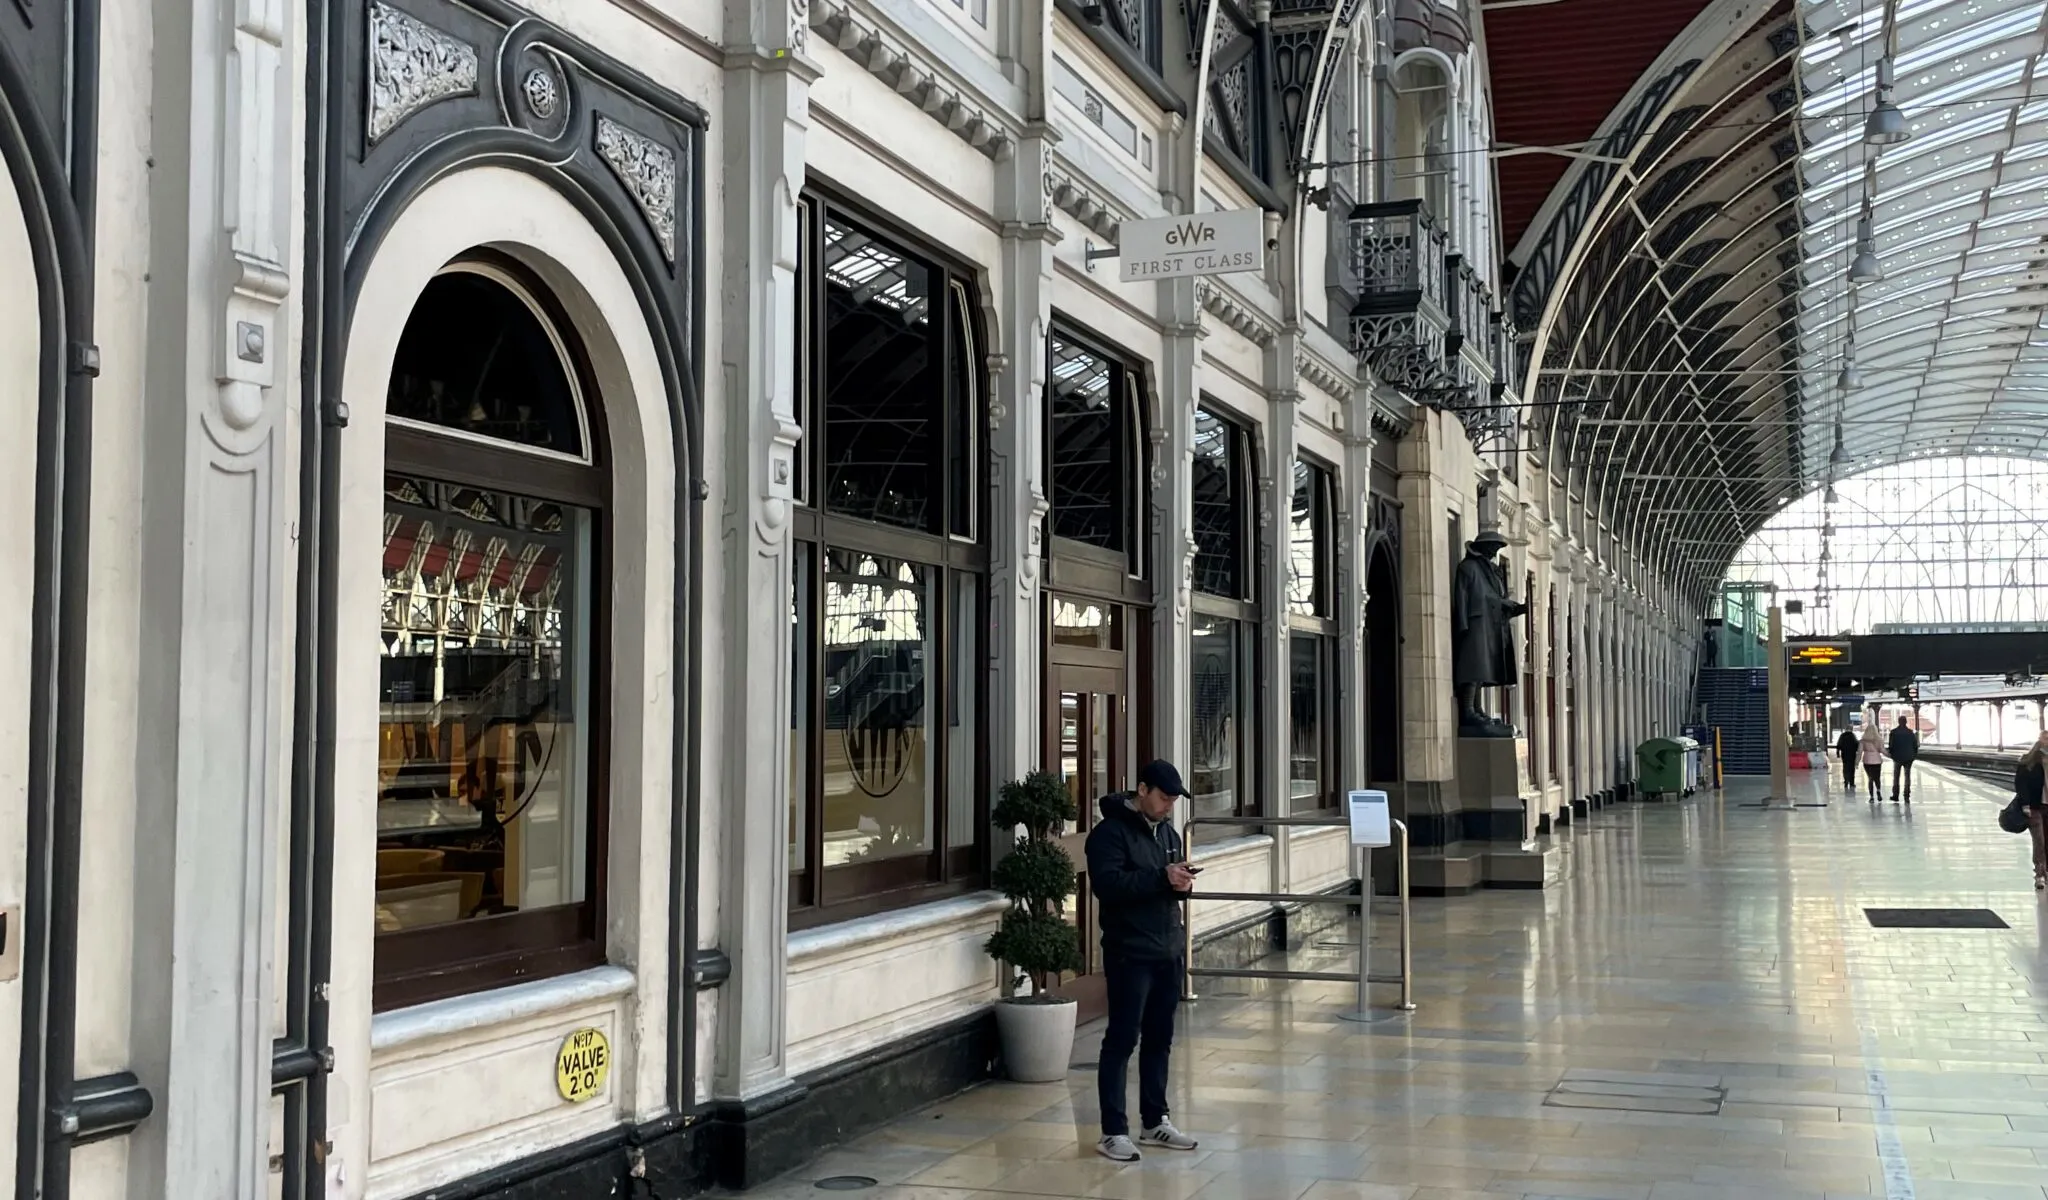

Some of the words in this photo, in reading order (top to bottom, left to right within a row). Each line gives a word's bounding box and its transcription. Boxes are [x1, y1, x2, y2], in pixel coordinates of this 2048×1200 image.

[1165, 219, 1216, 247] GWR
[1130, 258, 1183, 276] FIRST
[1194, 251, 1254, 270] CLASS
[562, 1045, 605, 1076] VALVE
